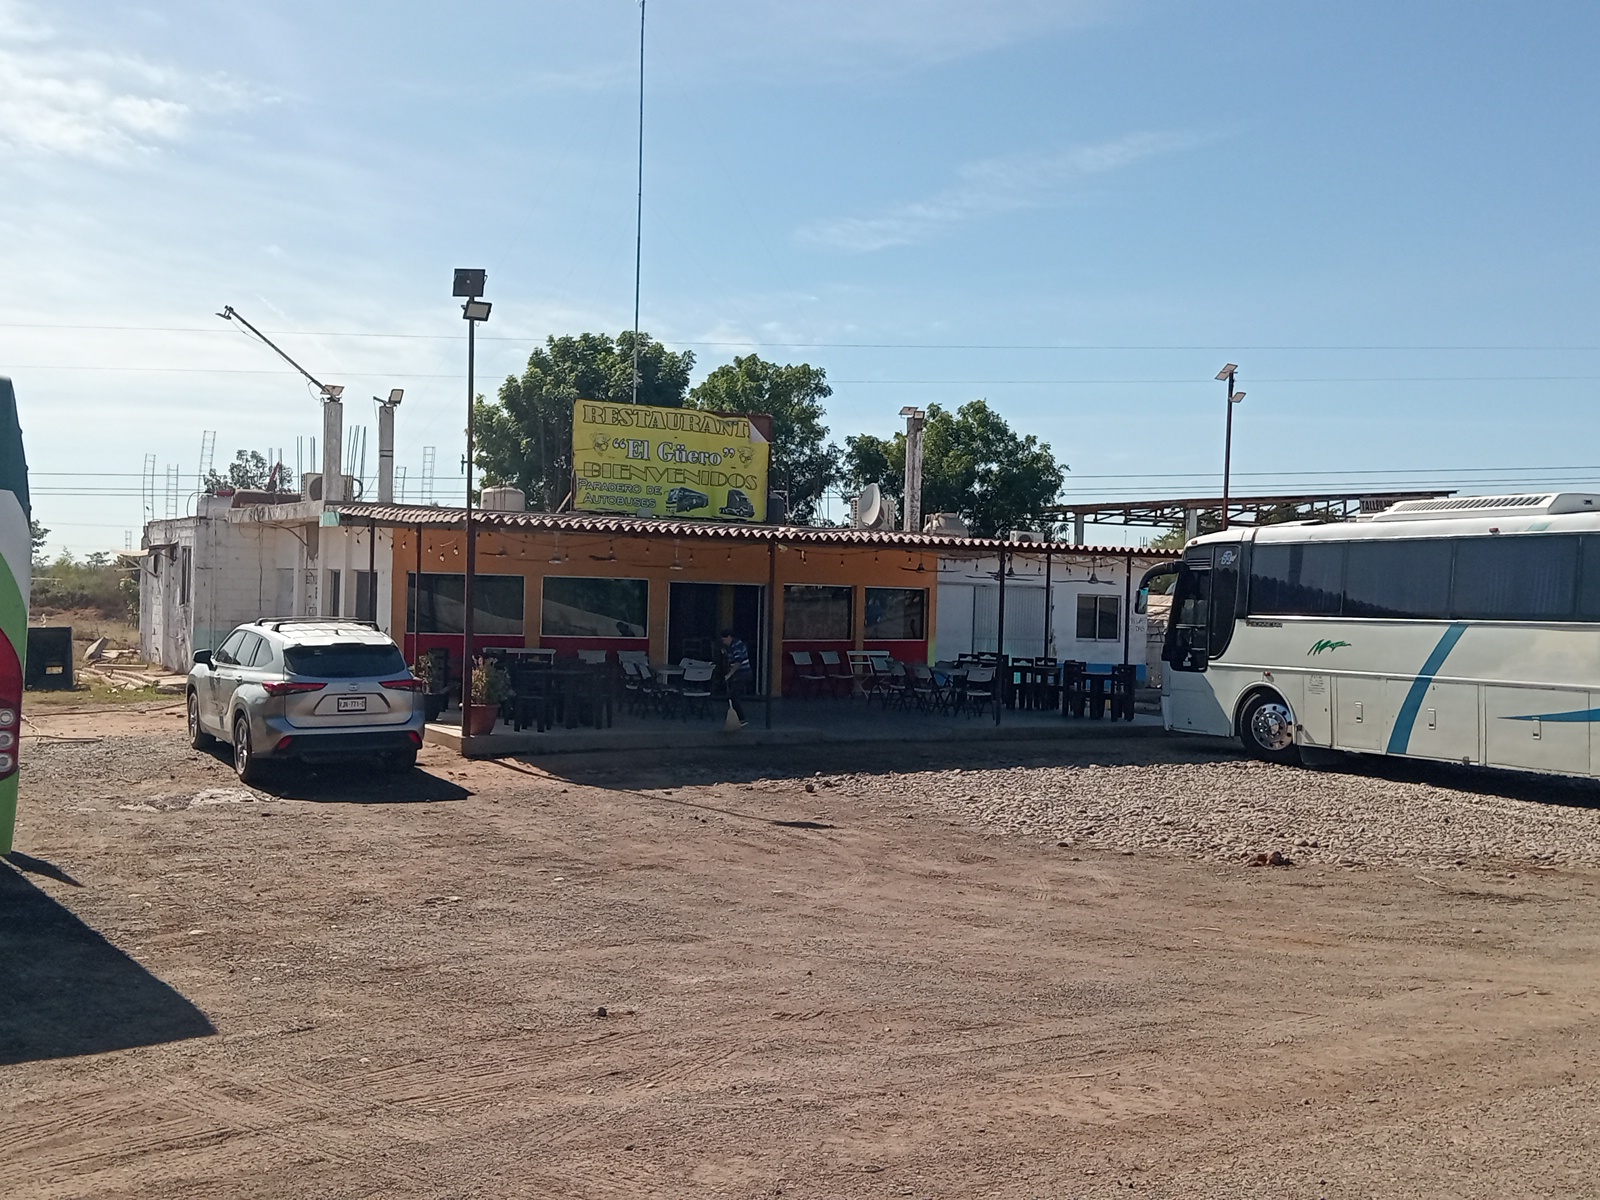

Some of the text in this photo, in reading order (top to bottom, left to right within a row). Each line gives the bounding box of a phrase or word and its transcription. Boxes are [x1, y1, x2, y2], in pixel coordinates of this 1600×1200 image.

[583, 404, 751, 438] RESTAURANT
[577, 478, 663, 496] PARADERO DE
[583, 461, 758, 490] BIENVENIDOS
[583, 493, 657, 508] AUTOBUSES
